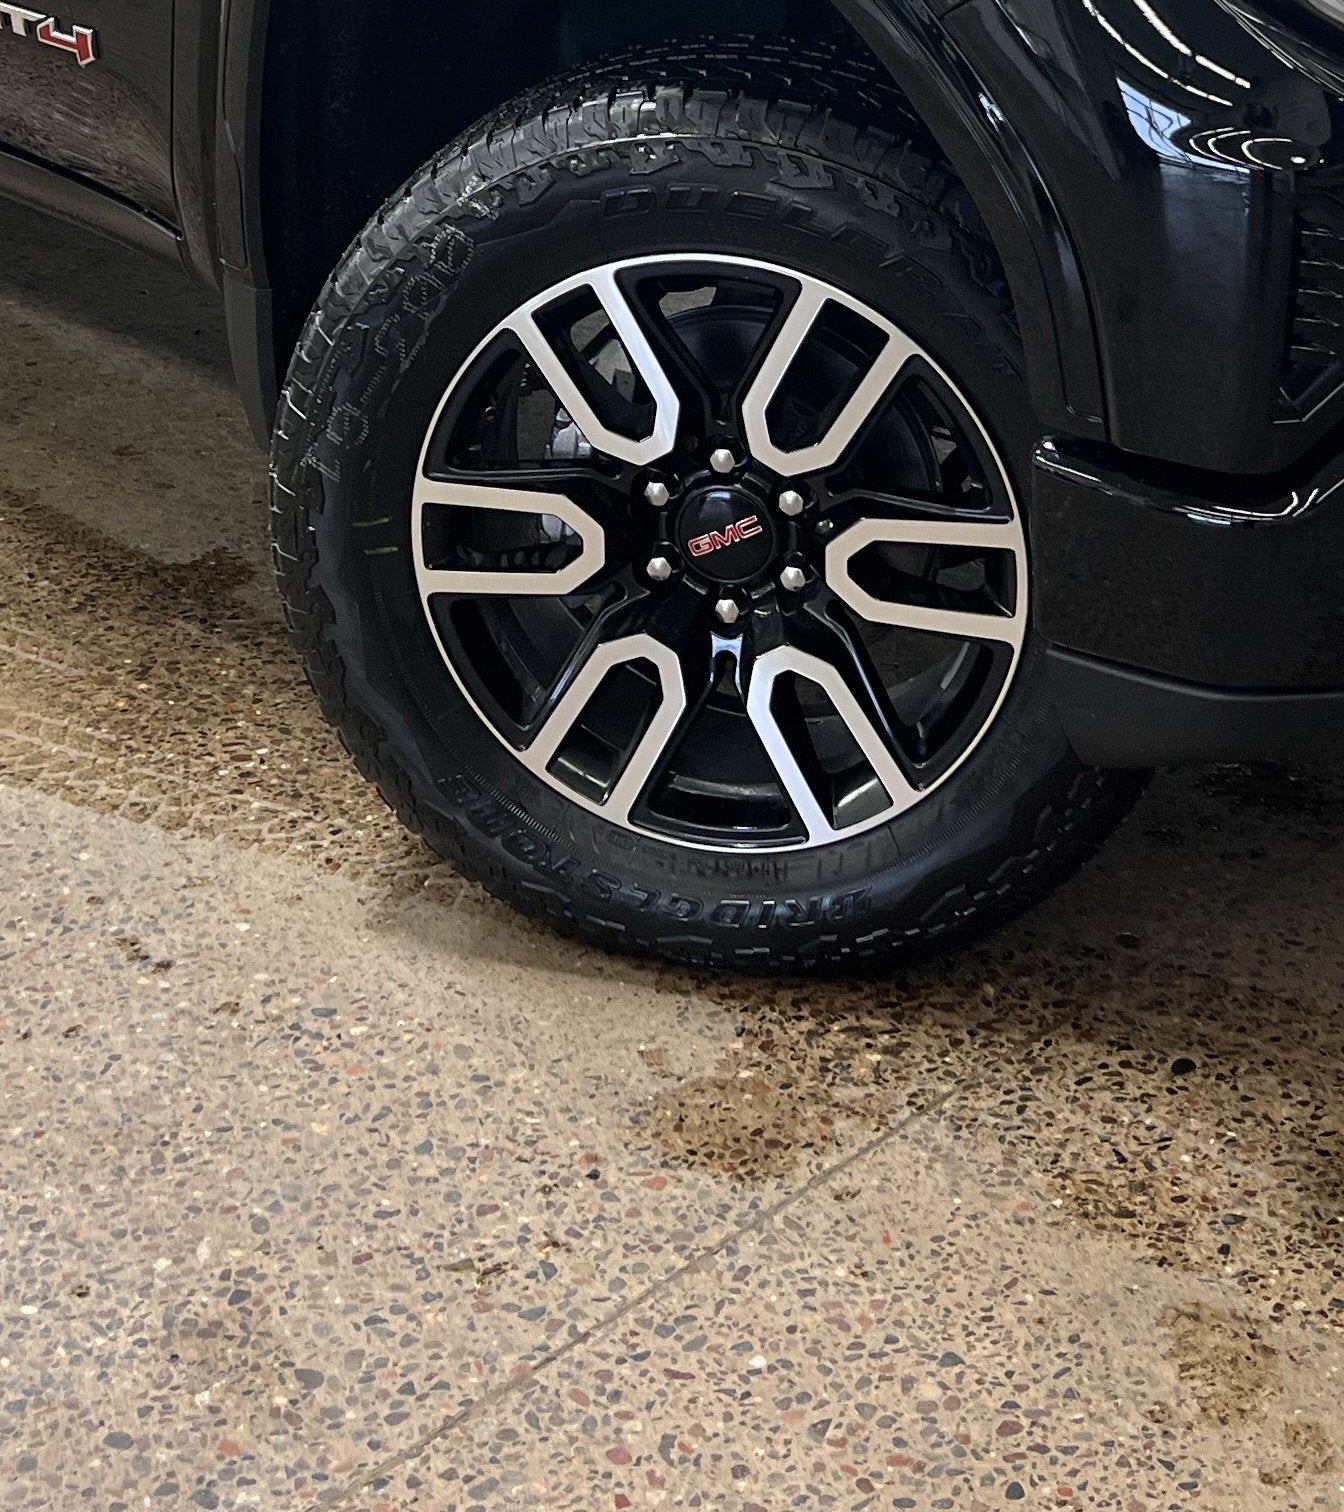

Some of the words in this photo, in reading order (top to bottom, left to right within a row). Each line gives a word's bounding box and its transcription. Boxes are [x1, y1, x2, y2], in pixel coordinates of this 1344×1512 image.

[600, 185, 946, 298] DUELER
[687, 514, 763, 557] GMC
[436, 774, 876, 932] BRIDGESTONE
